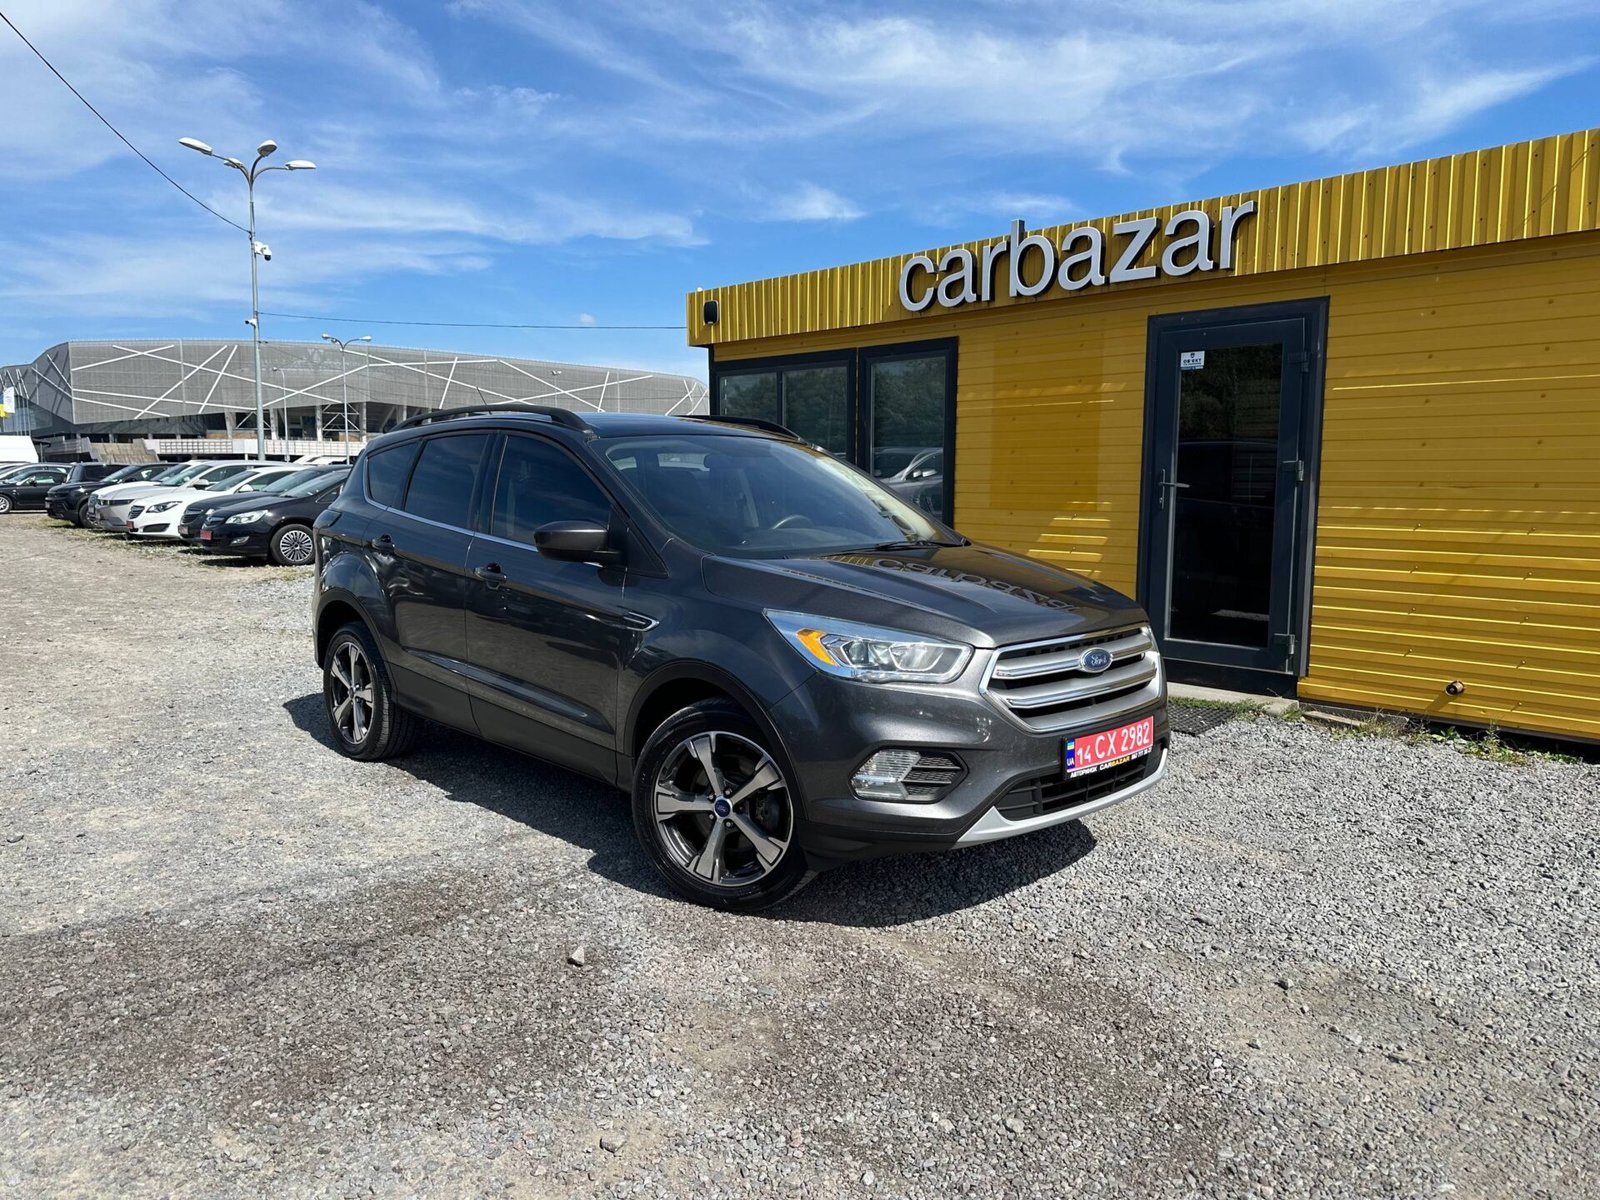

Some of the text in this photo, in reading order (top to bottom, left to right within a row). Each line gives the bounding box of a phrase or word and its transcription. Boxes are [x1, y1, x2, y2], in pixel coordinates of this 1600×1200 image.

[899, 200, 1257, 312] carbazar
[1067, 757, 1074, 767] UA
[1077, 745, 1091, 765] 14
[1095, 732, 1116, 759] CX
[1121, 721, 1150, 752] 2982
